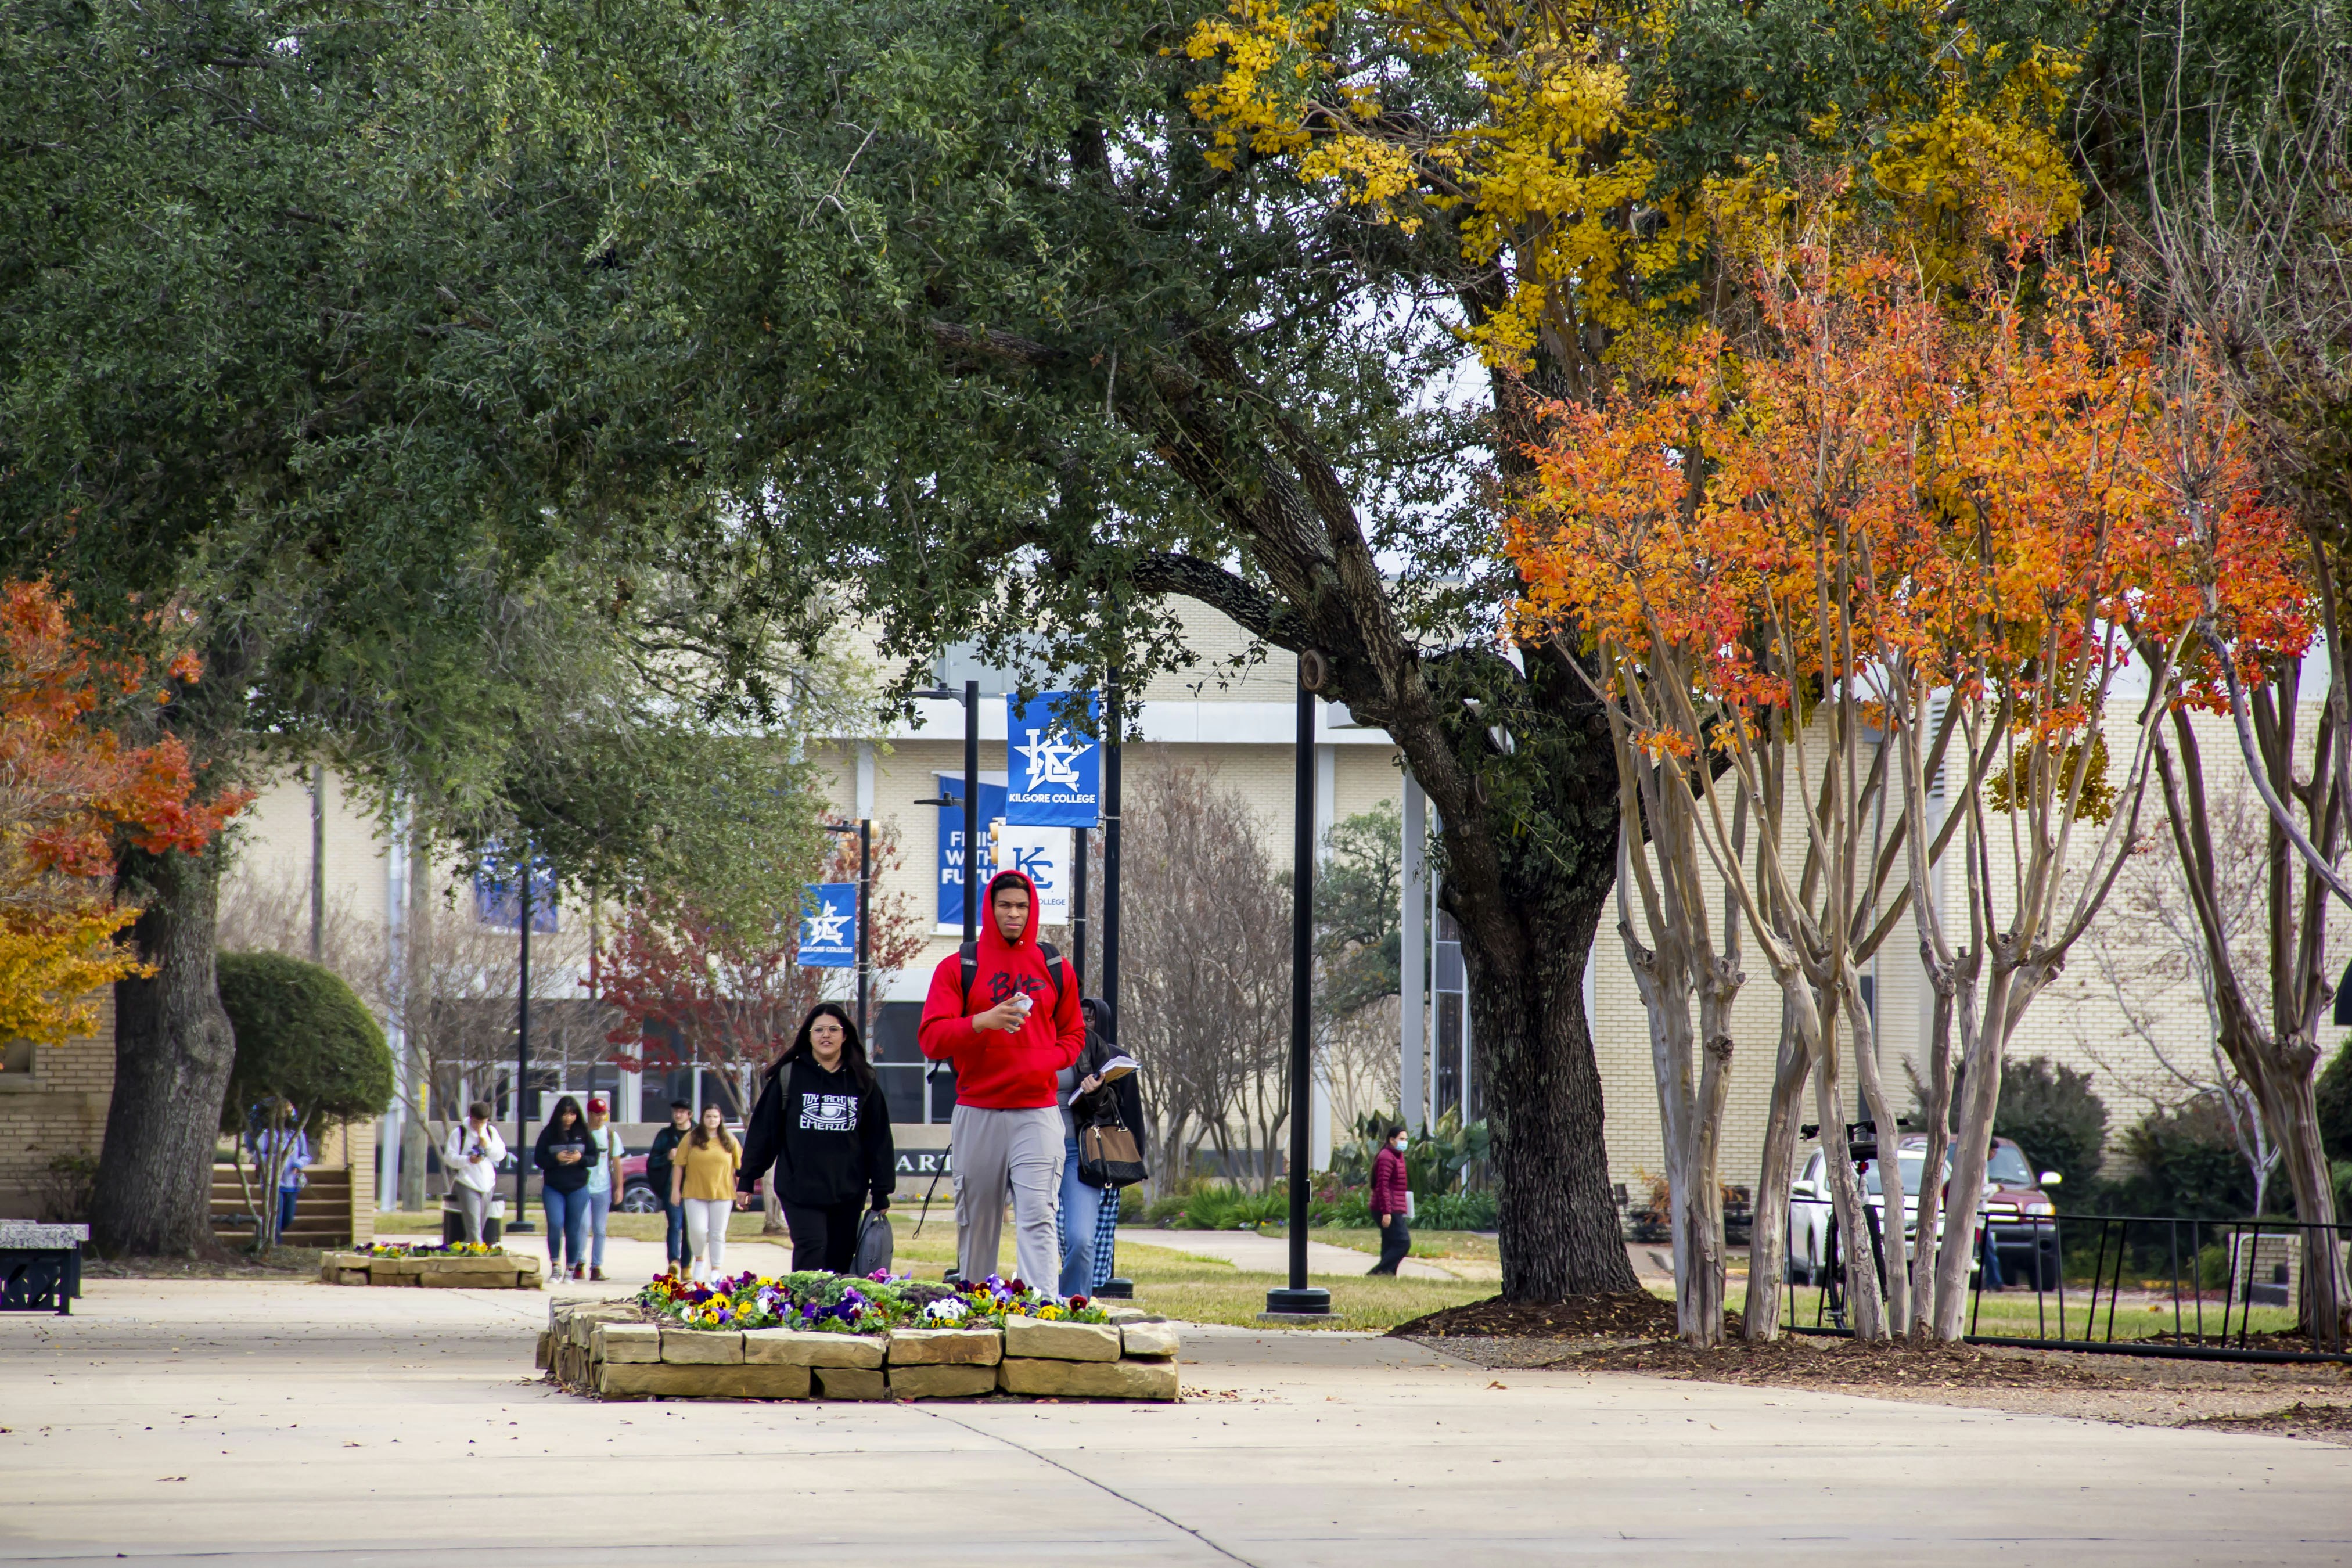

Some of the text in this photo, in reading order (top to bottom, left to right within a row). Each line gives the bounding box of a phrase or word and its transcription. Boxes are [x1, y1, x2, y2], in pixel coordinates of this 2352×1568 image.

[1009, 793, 1096, 804] KILGORE COLLEGE
[945, 850, 991, 866] WTH
[1013, 847, 1053, 889] KC
[802, 1094, 819, 1106] TOY
[800, 1114, 857, 1131] EMERICA
